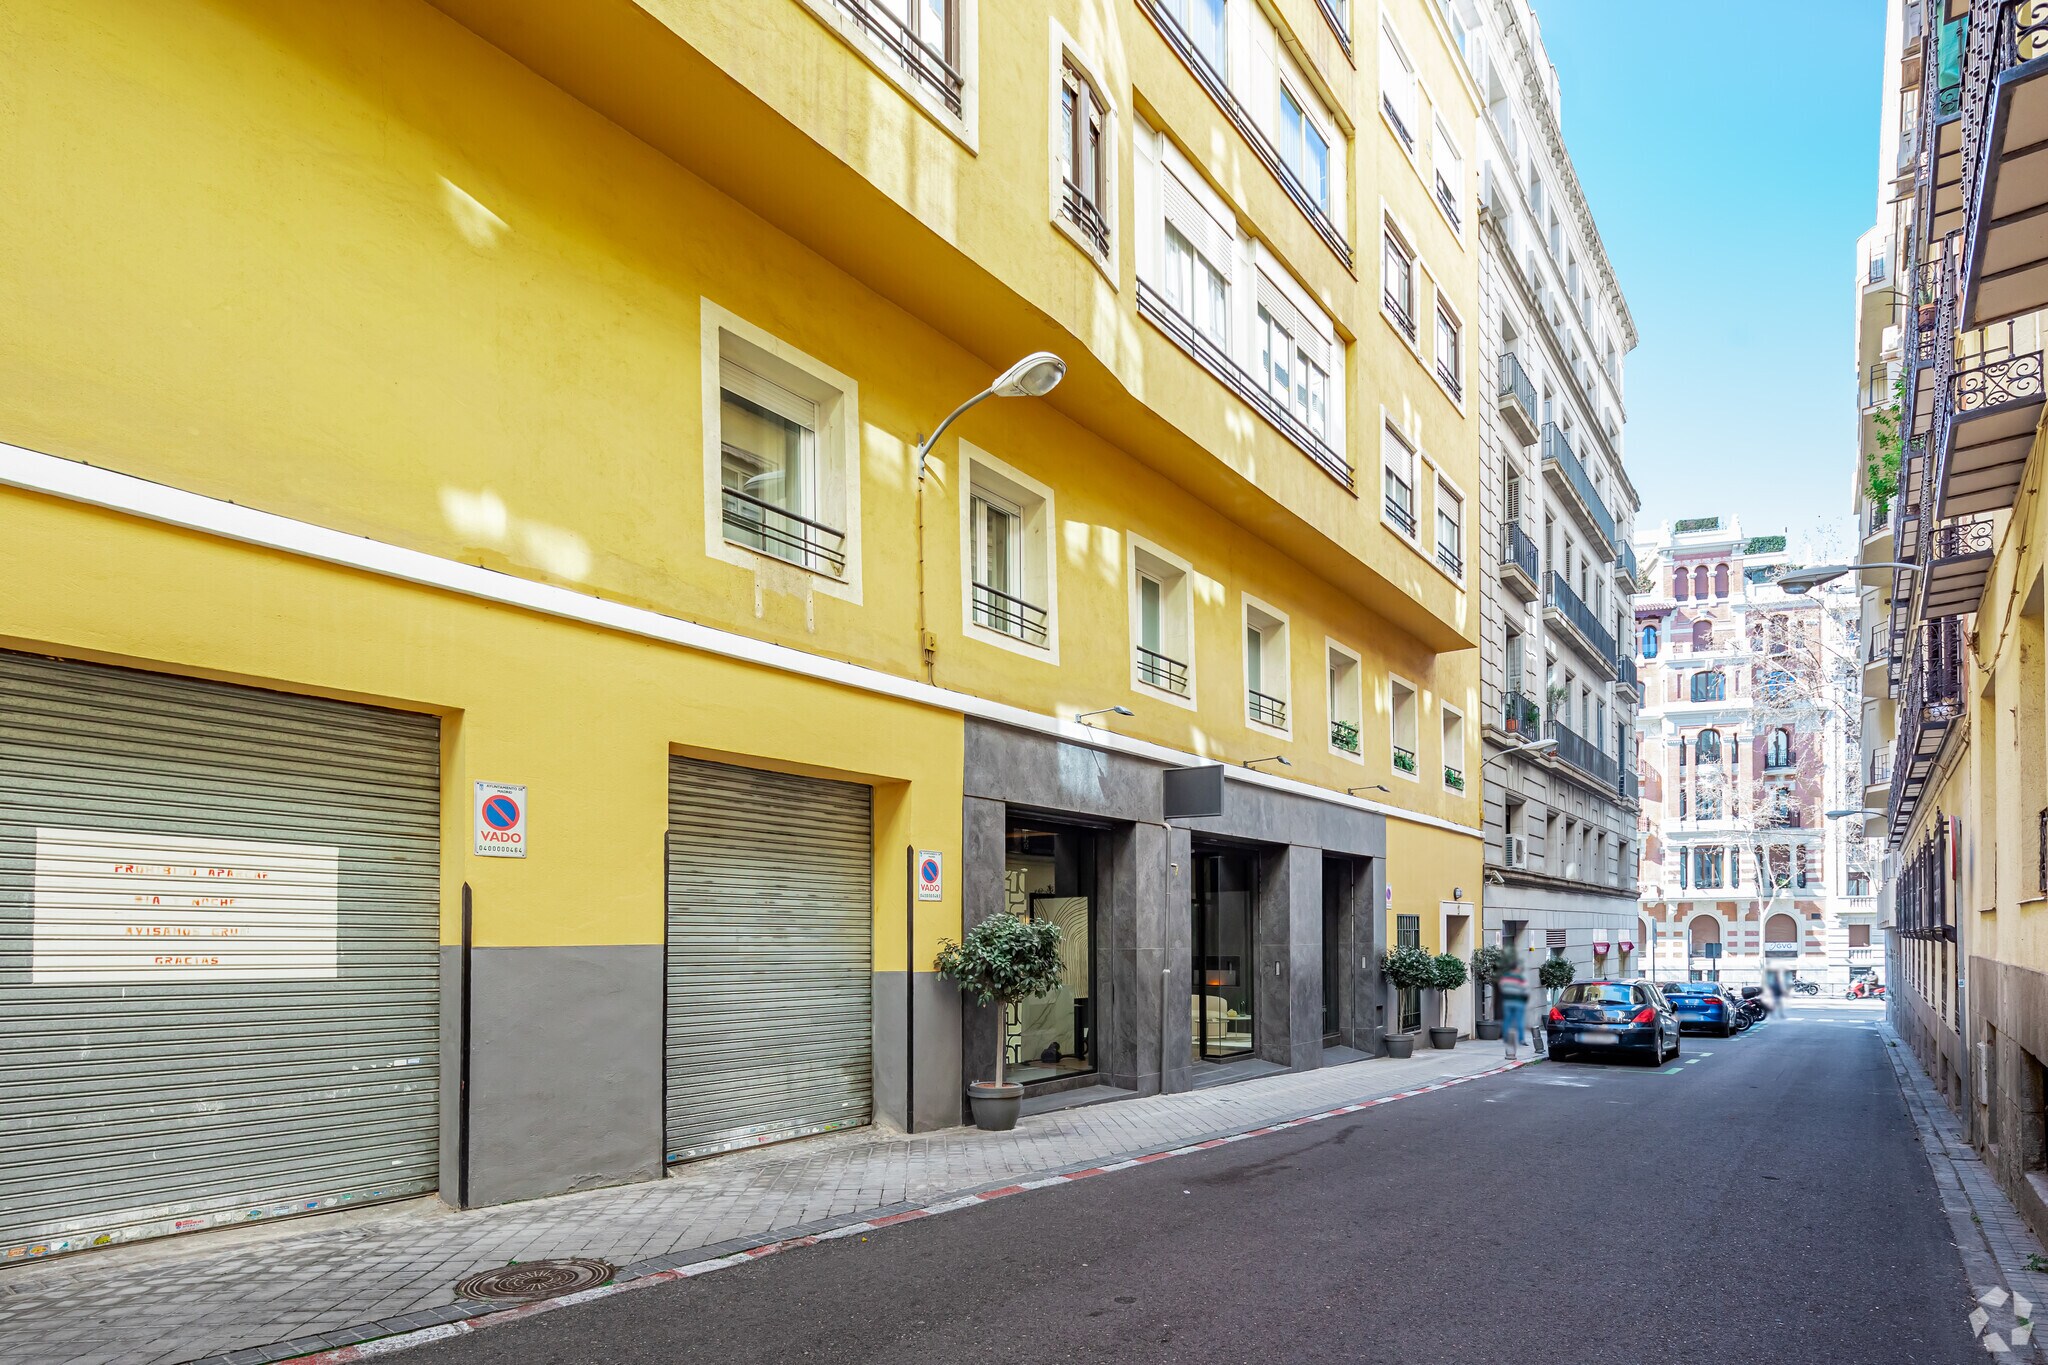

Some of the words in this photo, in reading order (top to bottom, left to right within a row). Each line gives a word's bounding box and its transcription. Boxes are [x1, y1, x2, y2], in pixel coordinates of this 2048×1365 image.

[481, 830, 521, 843] VADO
[921, 884, 940, 892] VADO
[154, 956, 219, 966] GRACIAS
